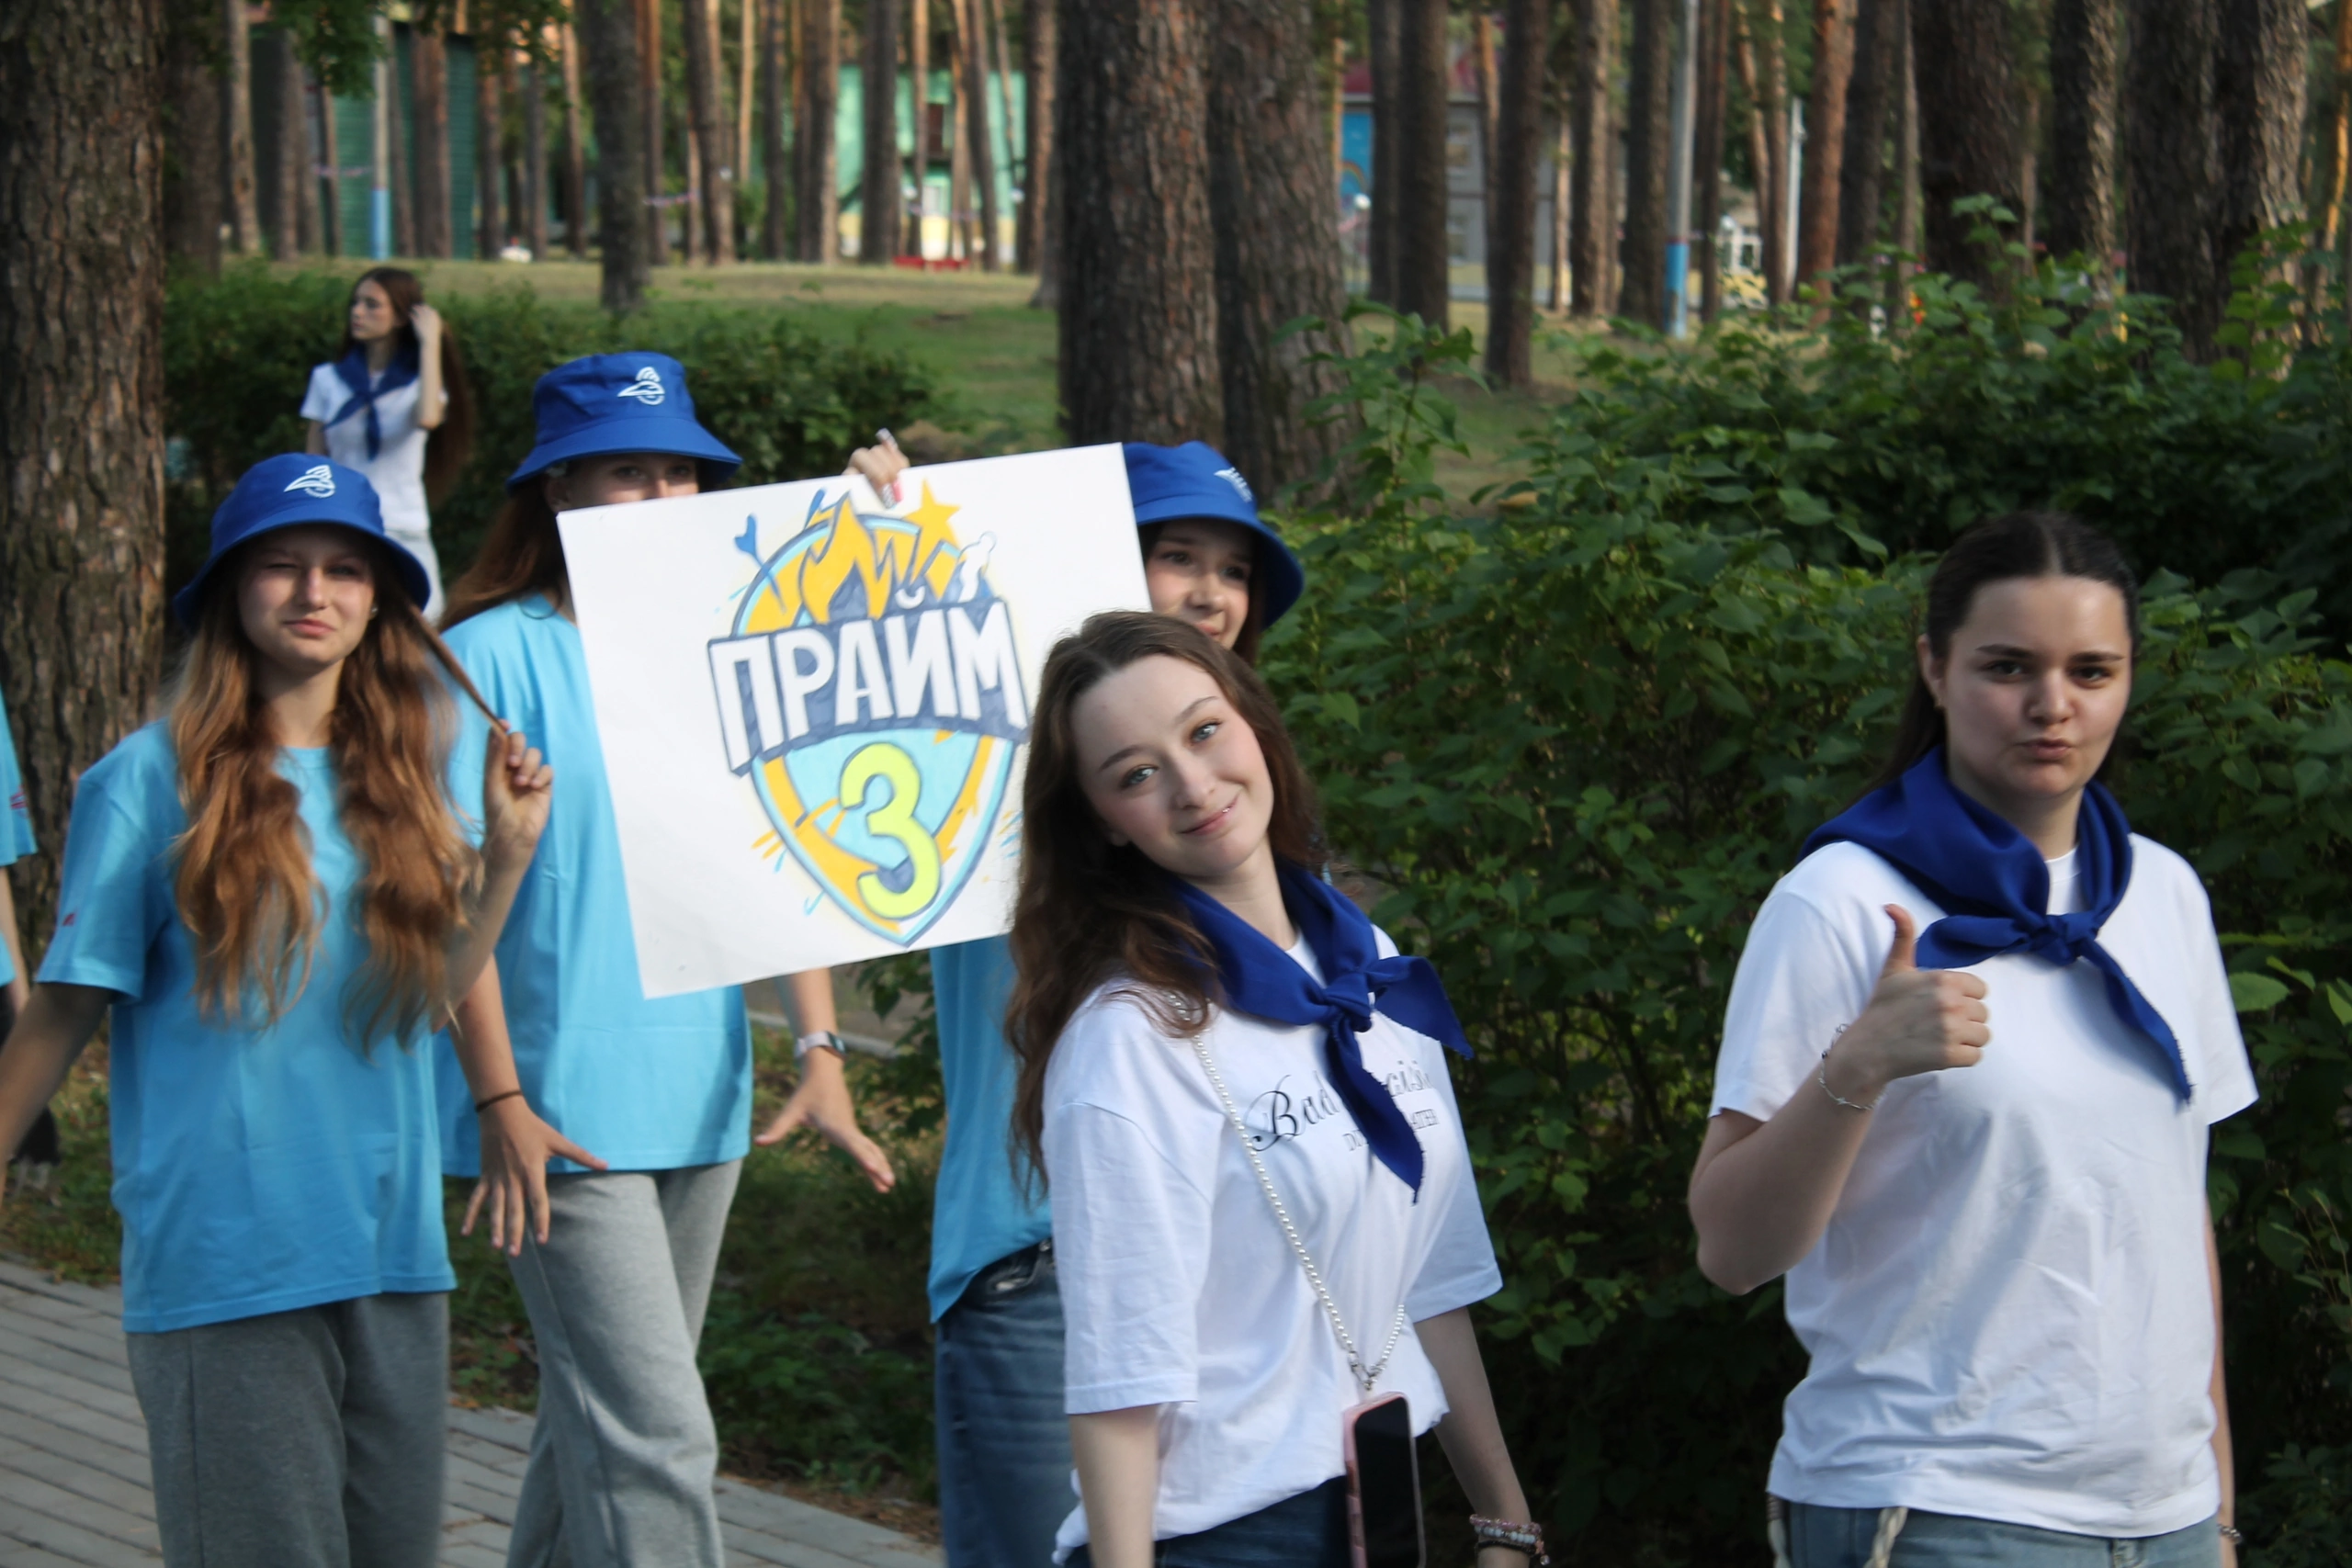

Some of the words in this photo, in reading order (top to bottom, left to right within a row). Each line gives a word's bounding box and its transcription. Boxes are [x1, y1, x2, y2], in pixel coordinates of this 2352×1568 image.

[709, 585, 1029, 773] ПРАЙМ
[839, 741, 941, 919] 3
[1242, 1070, 1340, 1152] Bad
